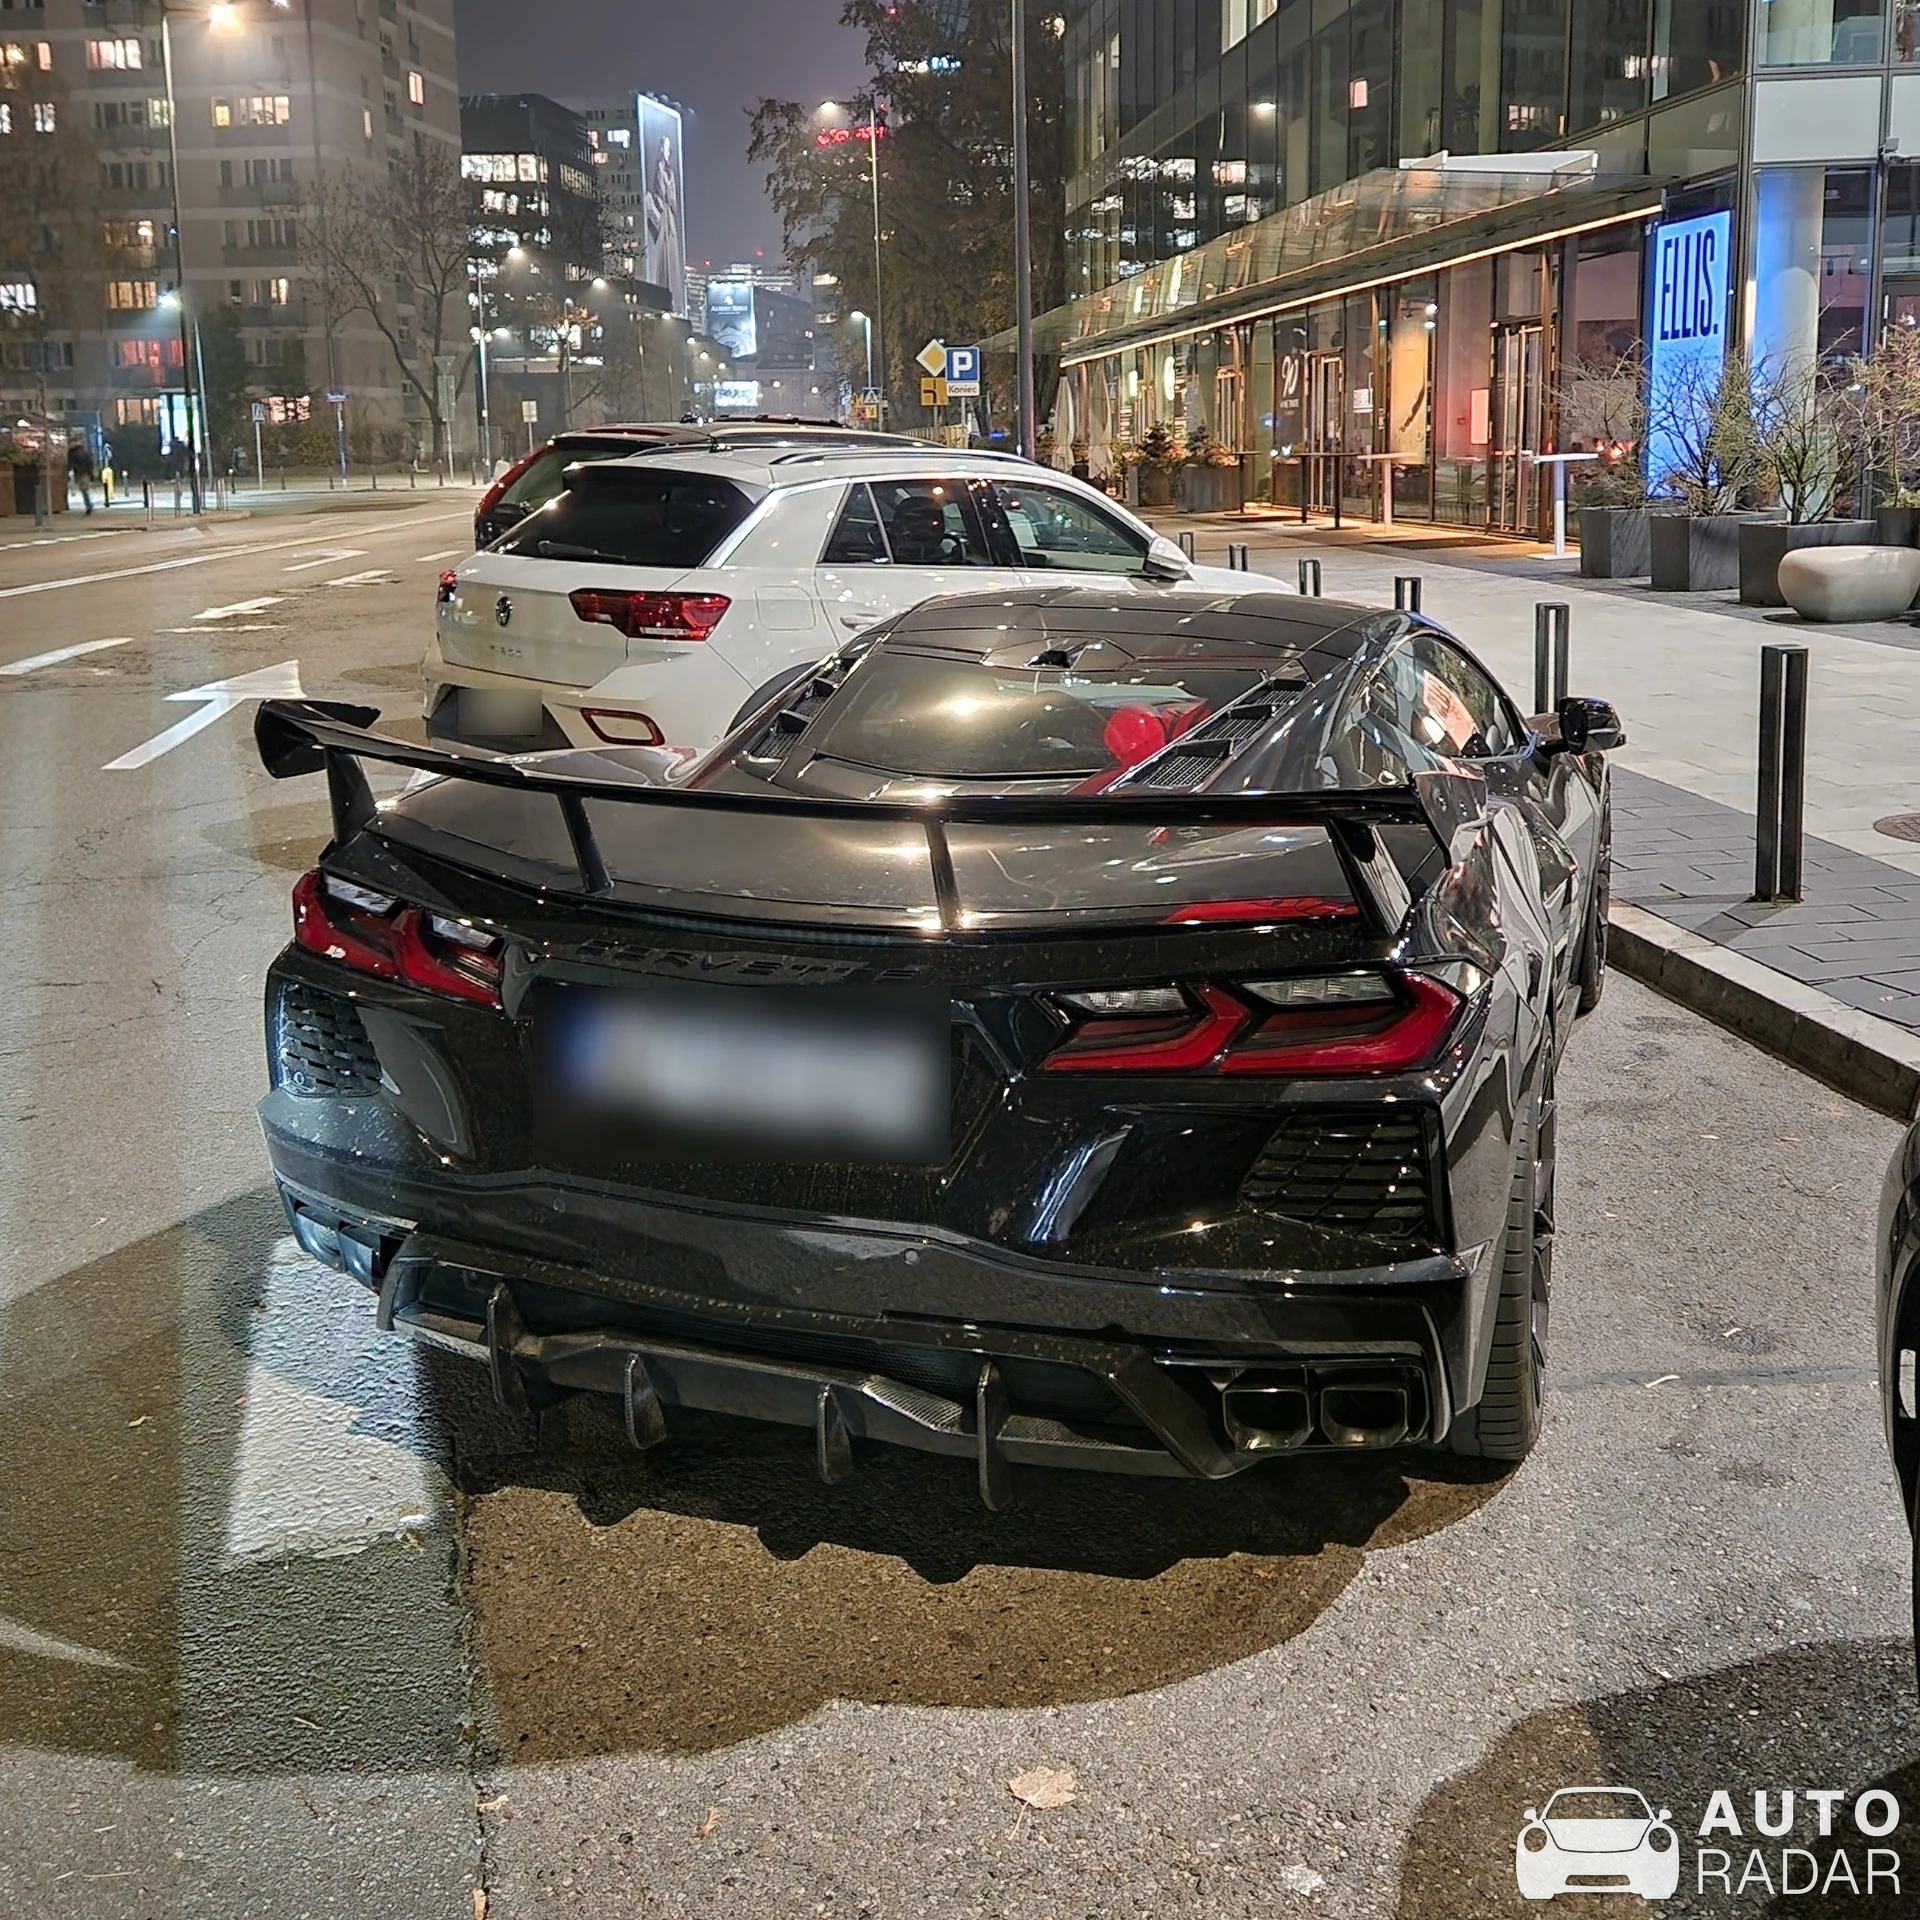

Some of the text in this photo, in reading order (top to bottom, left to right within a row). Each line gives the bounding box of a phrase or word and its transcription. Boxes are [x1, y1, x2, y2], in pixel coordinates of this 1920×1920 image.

[1660, 228, 1718, 341] ELLIS.
[952, 350, 973, 379] P
[948, 384, 977, 394] Koniec
